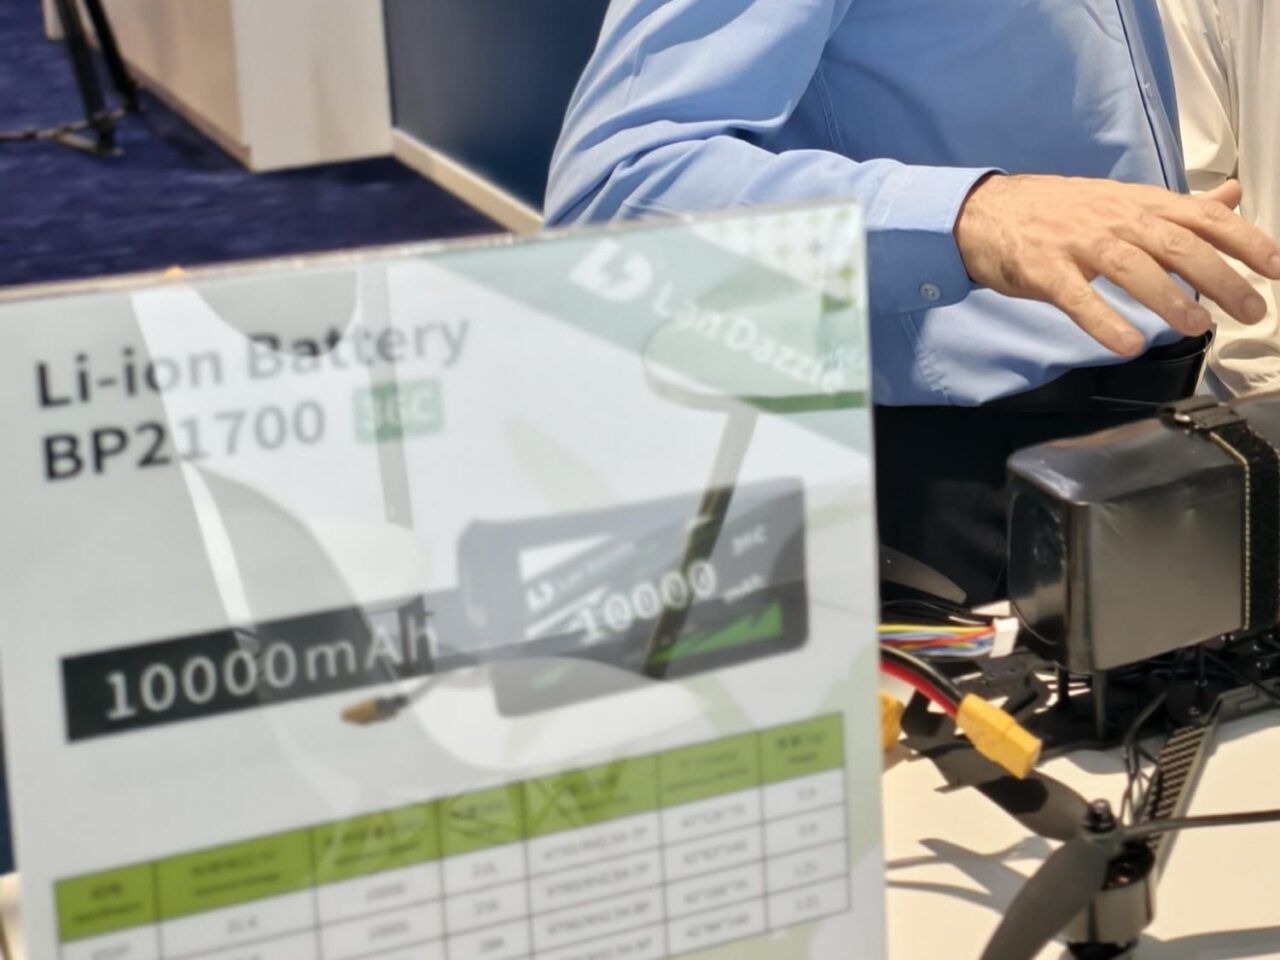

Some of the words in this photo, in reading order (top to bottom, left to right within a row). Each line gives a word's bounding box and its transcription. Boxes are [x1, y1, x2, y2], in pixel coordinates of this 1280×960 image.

[36, 348, 225, 410] Li-ion
[247, 315, 470, 382] Battery
[652, 280, 724, 337] Lan
[723, 316, 845, 392] Dazzle
[42, 401, 328, 482] BP21700
[578, 559, 716, 645] 10000
[104, 605, 438, 721] 10000mAh
